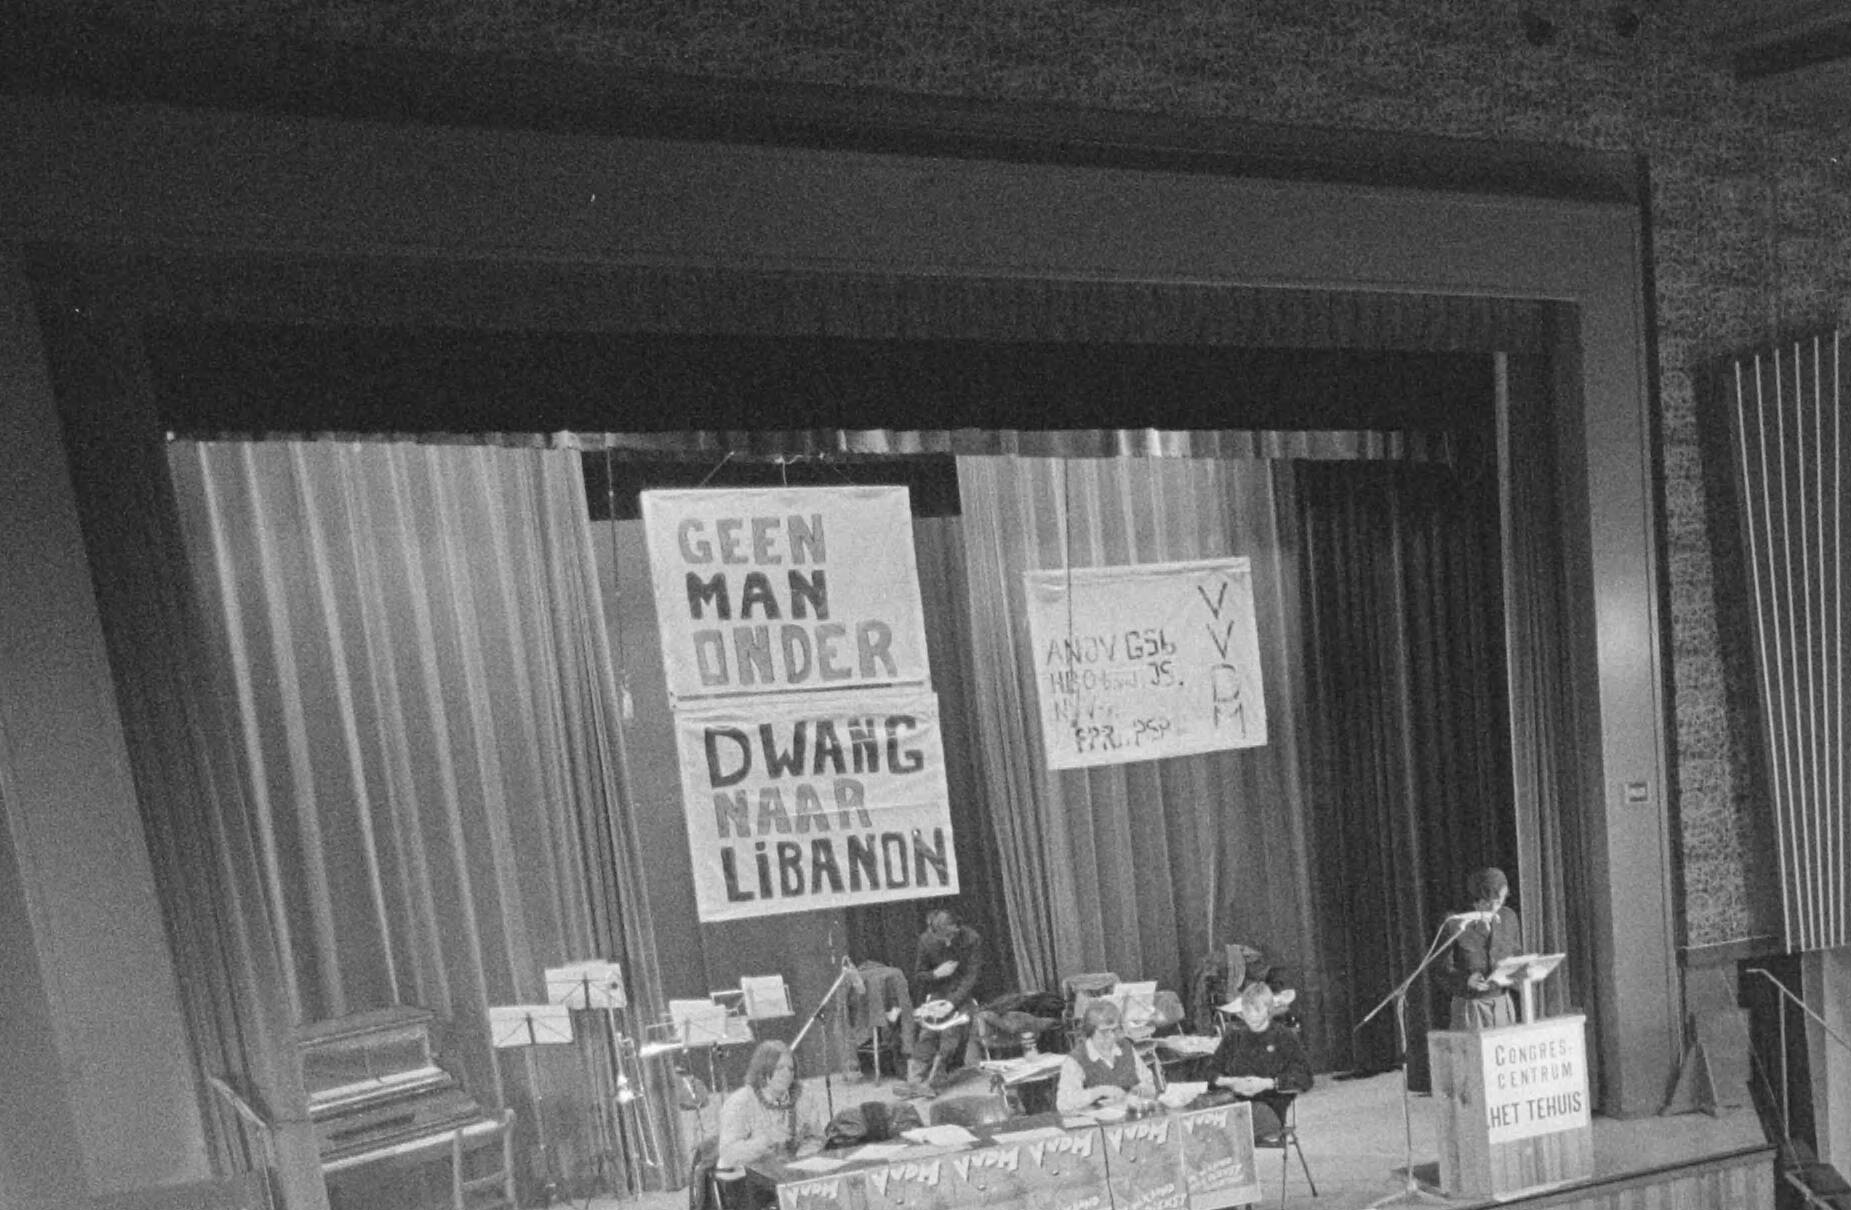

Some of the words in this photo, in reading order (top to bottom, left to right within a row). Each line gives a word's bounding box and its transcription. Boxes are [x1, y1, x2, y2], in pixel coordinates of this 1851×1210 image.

[678, 513, 827, 565] GEEN
[685, 569, 829, 620] MAN
[693, 619, 898, 686] ONDER
[704, 715, 925, 789] DWANG
[713, 778, 872, 838] NAAR
[1497, 1061, 1573, 1090] CENTRUM
[1489, 1101, 1521, 1129] HET
[1527, 1091, 1583, 1121] TEHUIS
